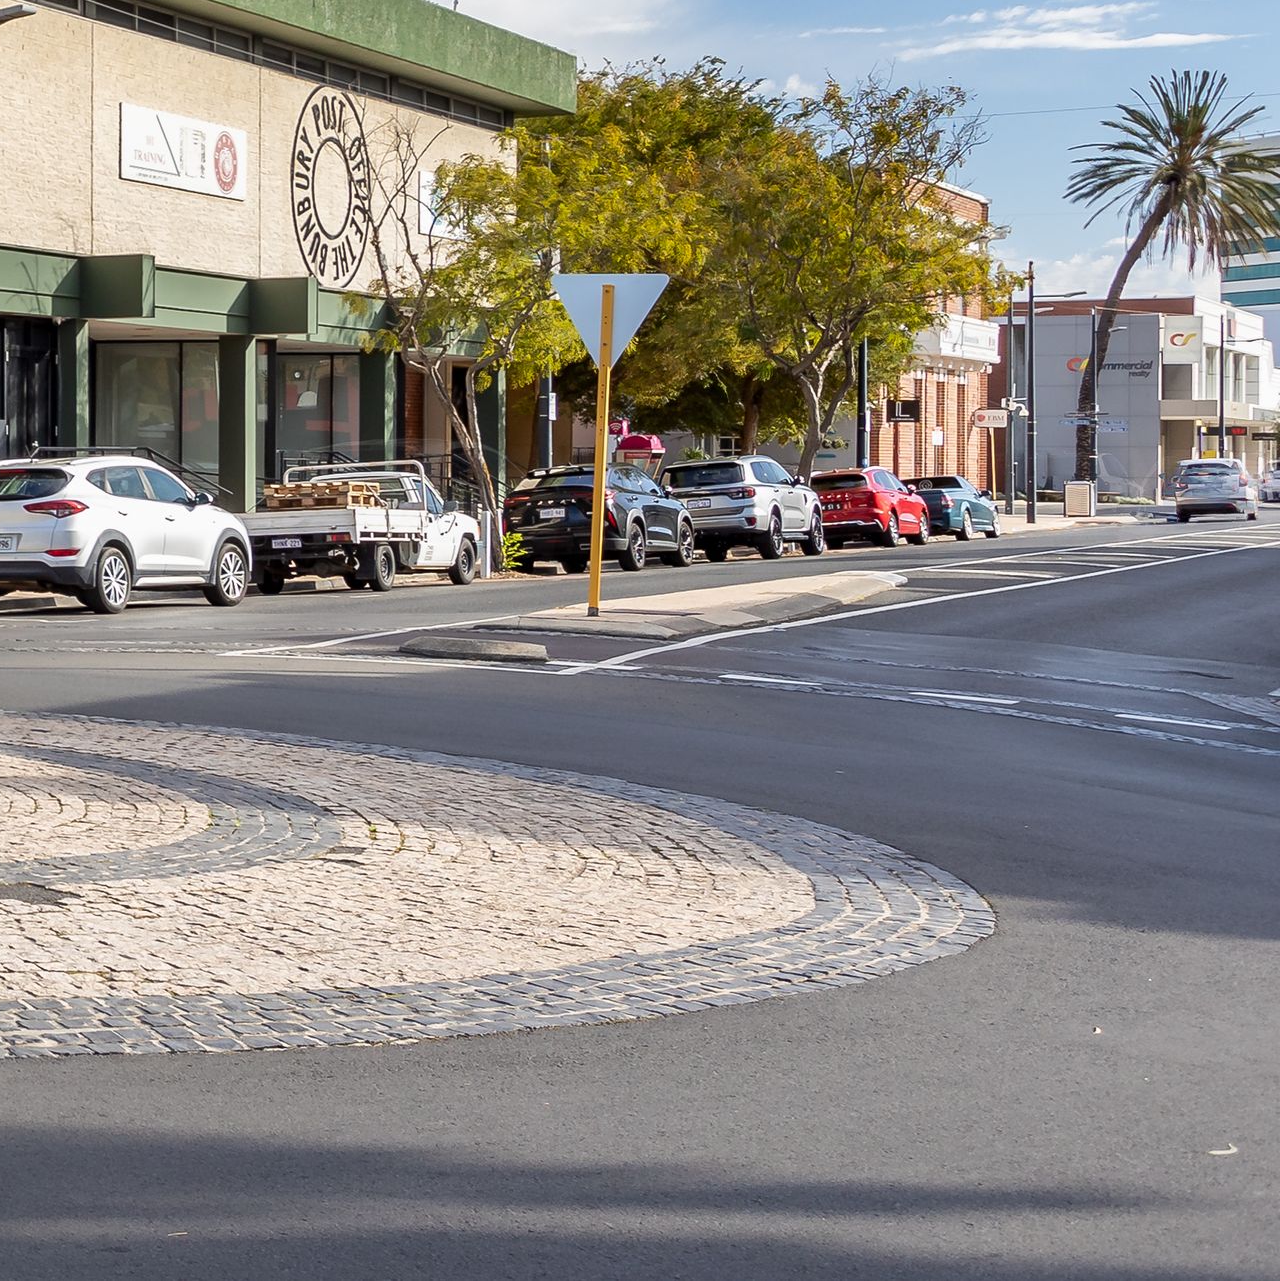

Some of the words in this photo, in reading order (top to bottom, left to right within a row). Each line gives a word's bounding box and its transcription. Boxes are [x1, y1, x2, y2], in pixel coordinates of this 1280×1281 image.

[311, 95, 346, 137] POST
[295, 126, 329, 277] BUNBURY
[332, 235, 357, 281] THE
